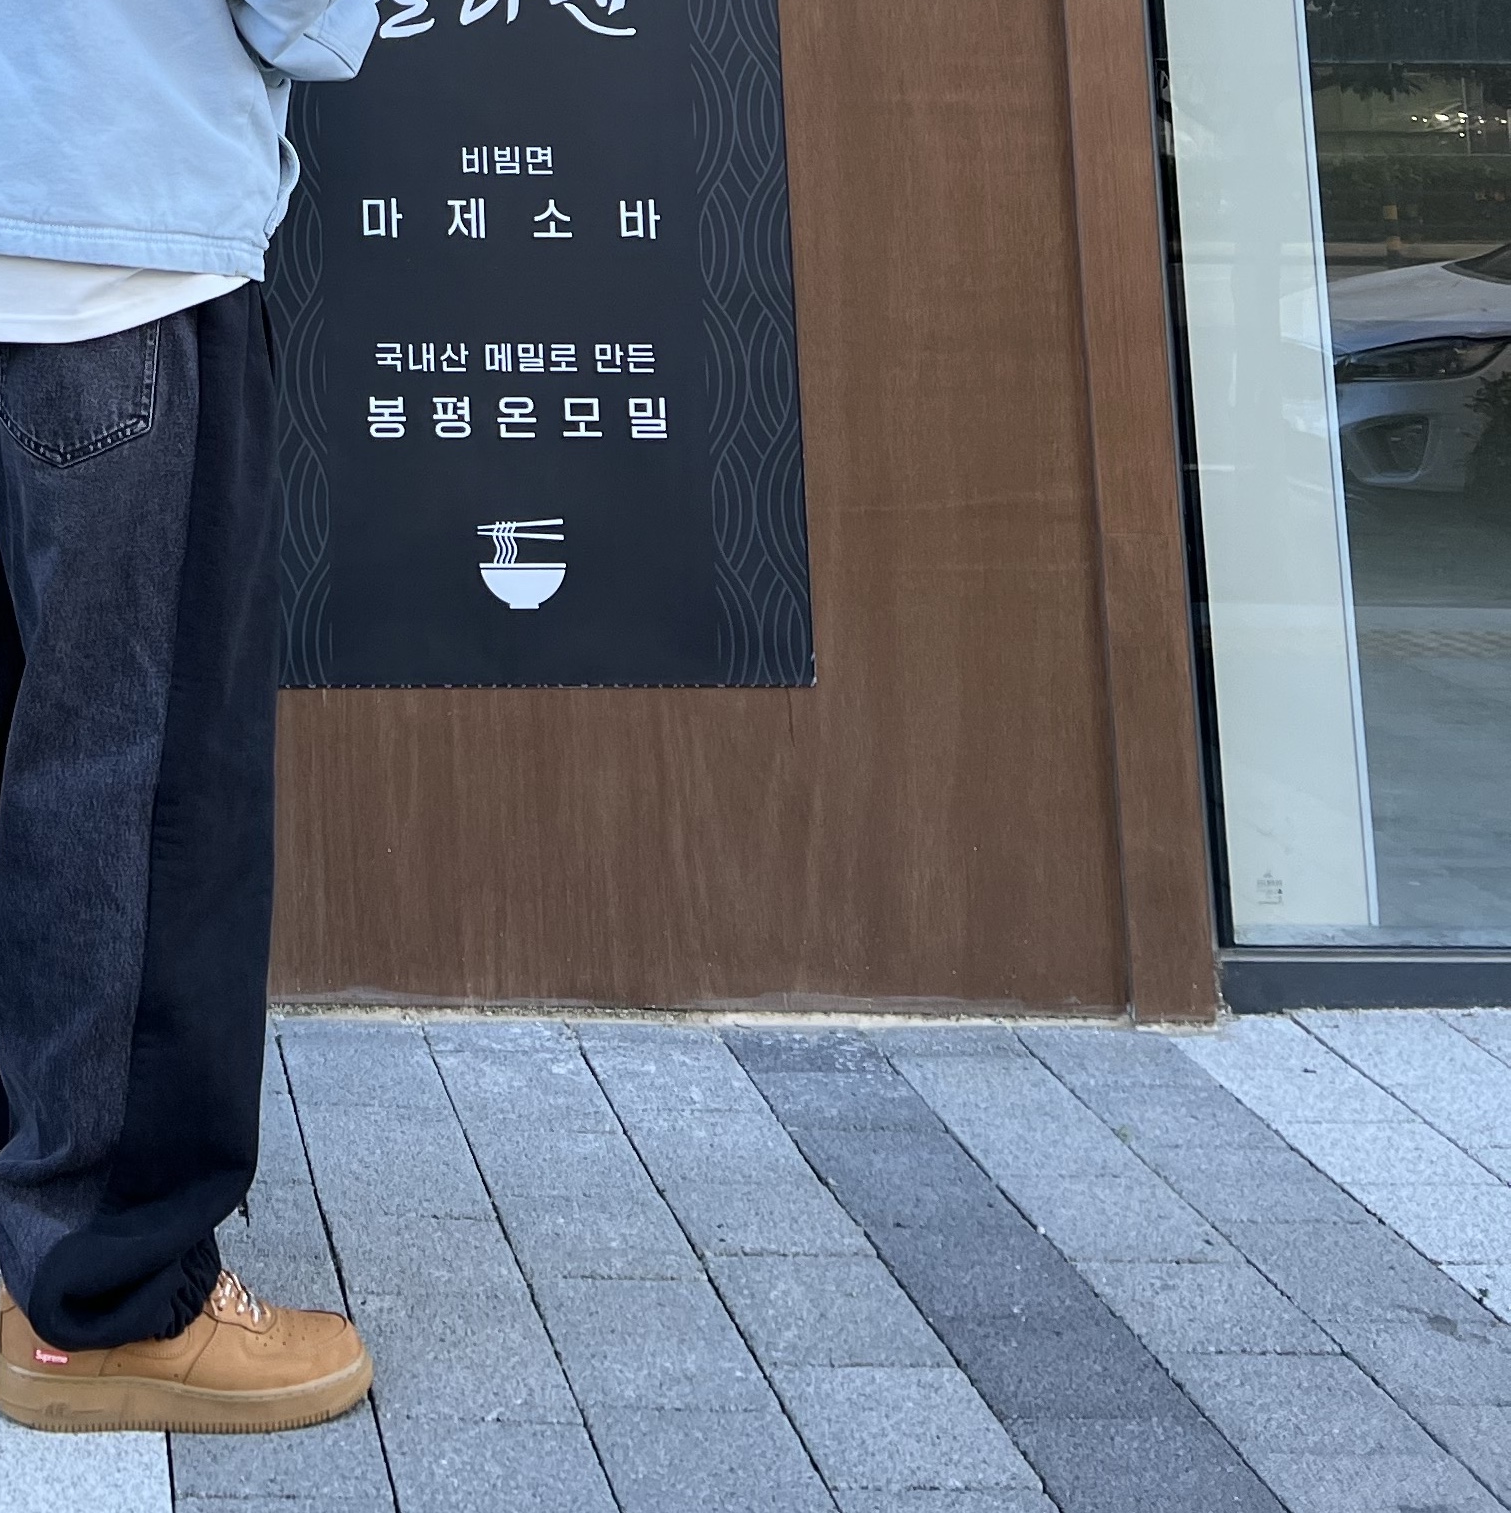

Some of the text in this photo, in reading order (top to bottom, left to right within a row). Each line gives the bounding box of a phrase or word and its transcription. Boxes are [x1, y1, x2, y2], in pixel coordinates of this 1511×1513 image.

[461, 145, 555, 176] 비빔면
[374, 341, 657, 375] 국내산 메밀로 만든
